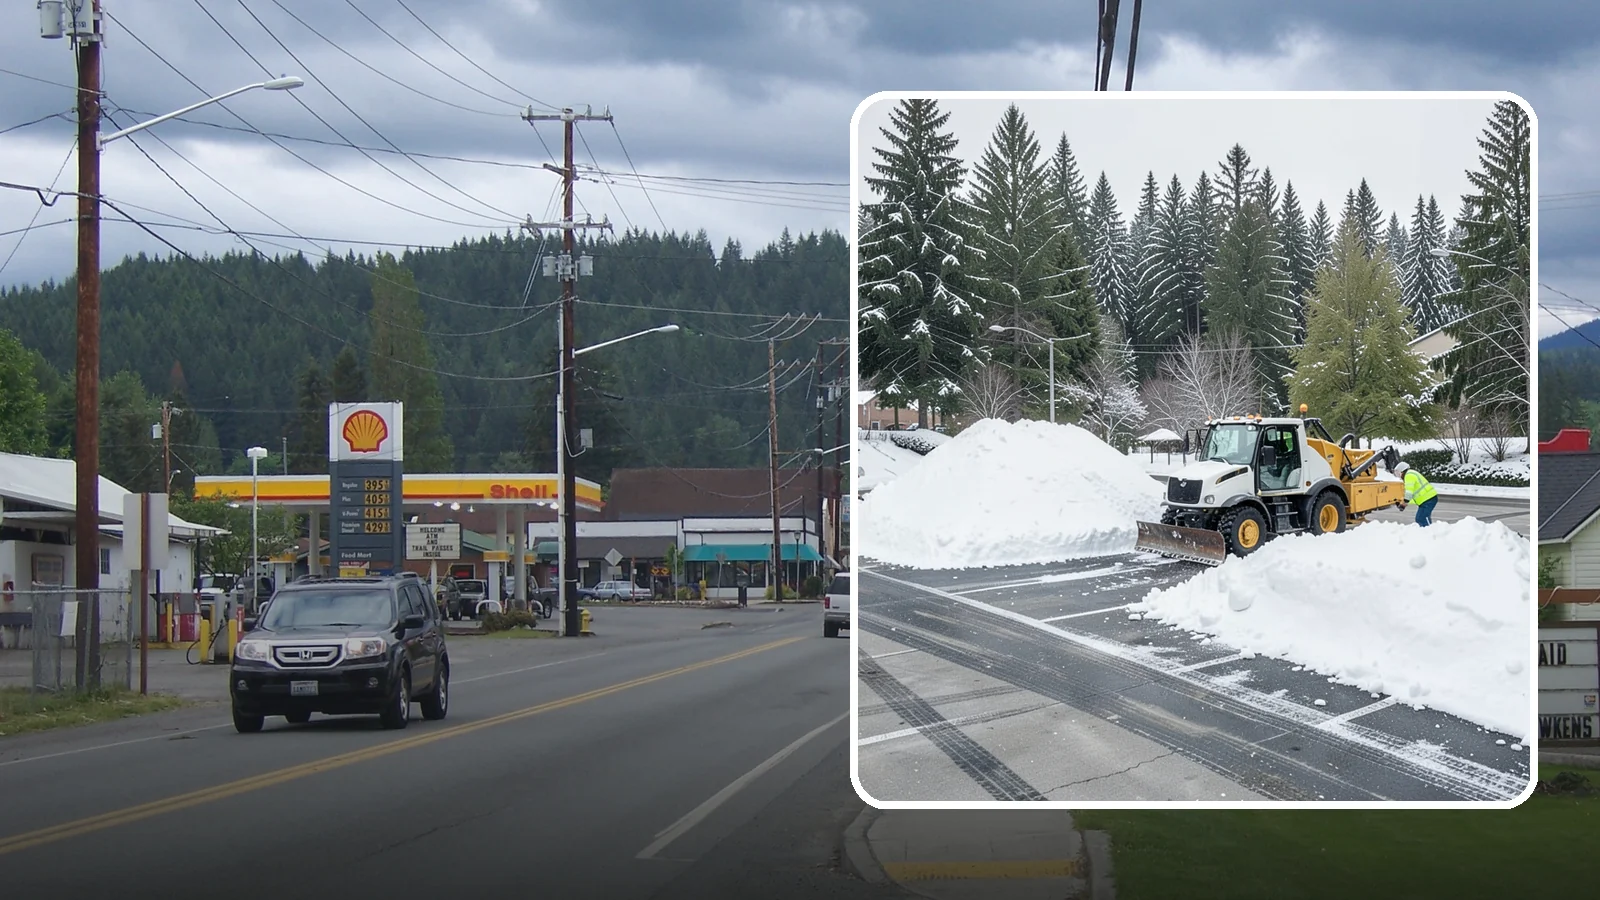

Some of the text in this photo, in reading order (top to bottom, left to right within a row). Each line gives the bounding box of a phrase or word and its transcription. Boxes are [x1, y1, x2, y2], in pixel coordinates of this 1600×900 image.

[366, 480, 384, 490] 395
[490, 484, 547, 499] Shell
[366, 494, 384, 504] 405
[366, 508, 384, 518] 415
[366, 522, 384, 532] 429
[1539, 642, 1567, 665] AID
